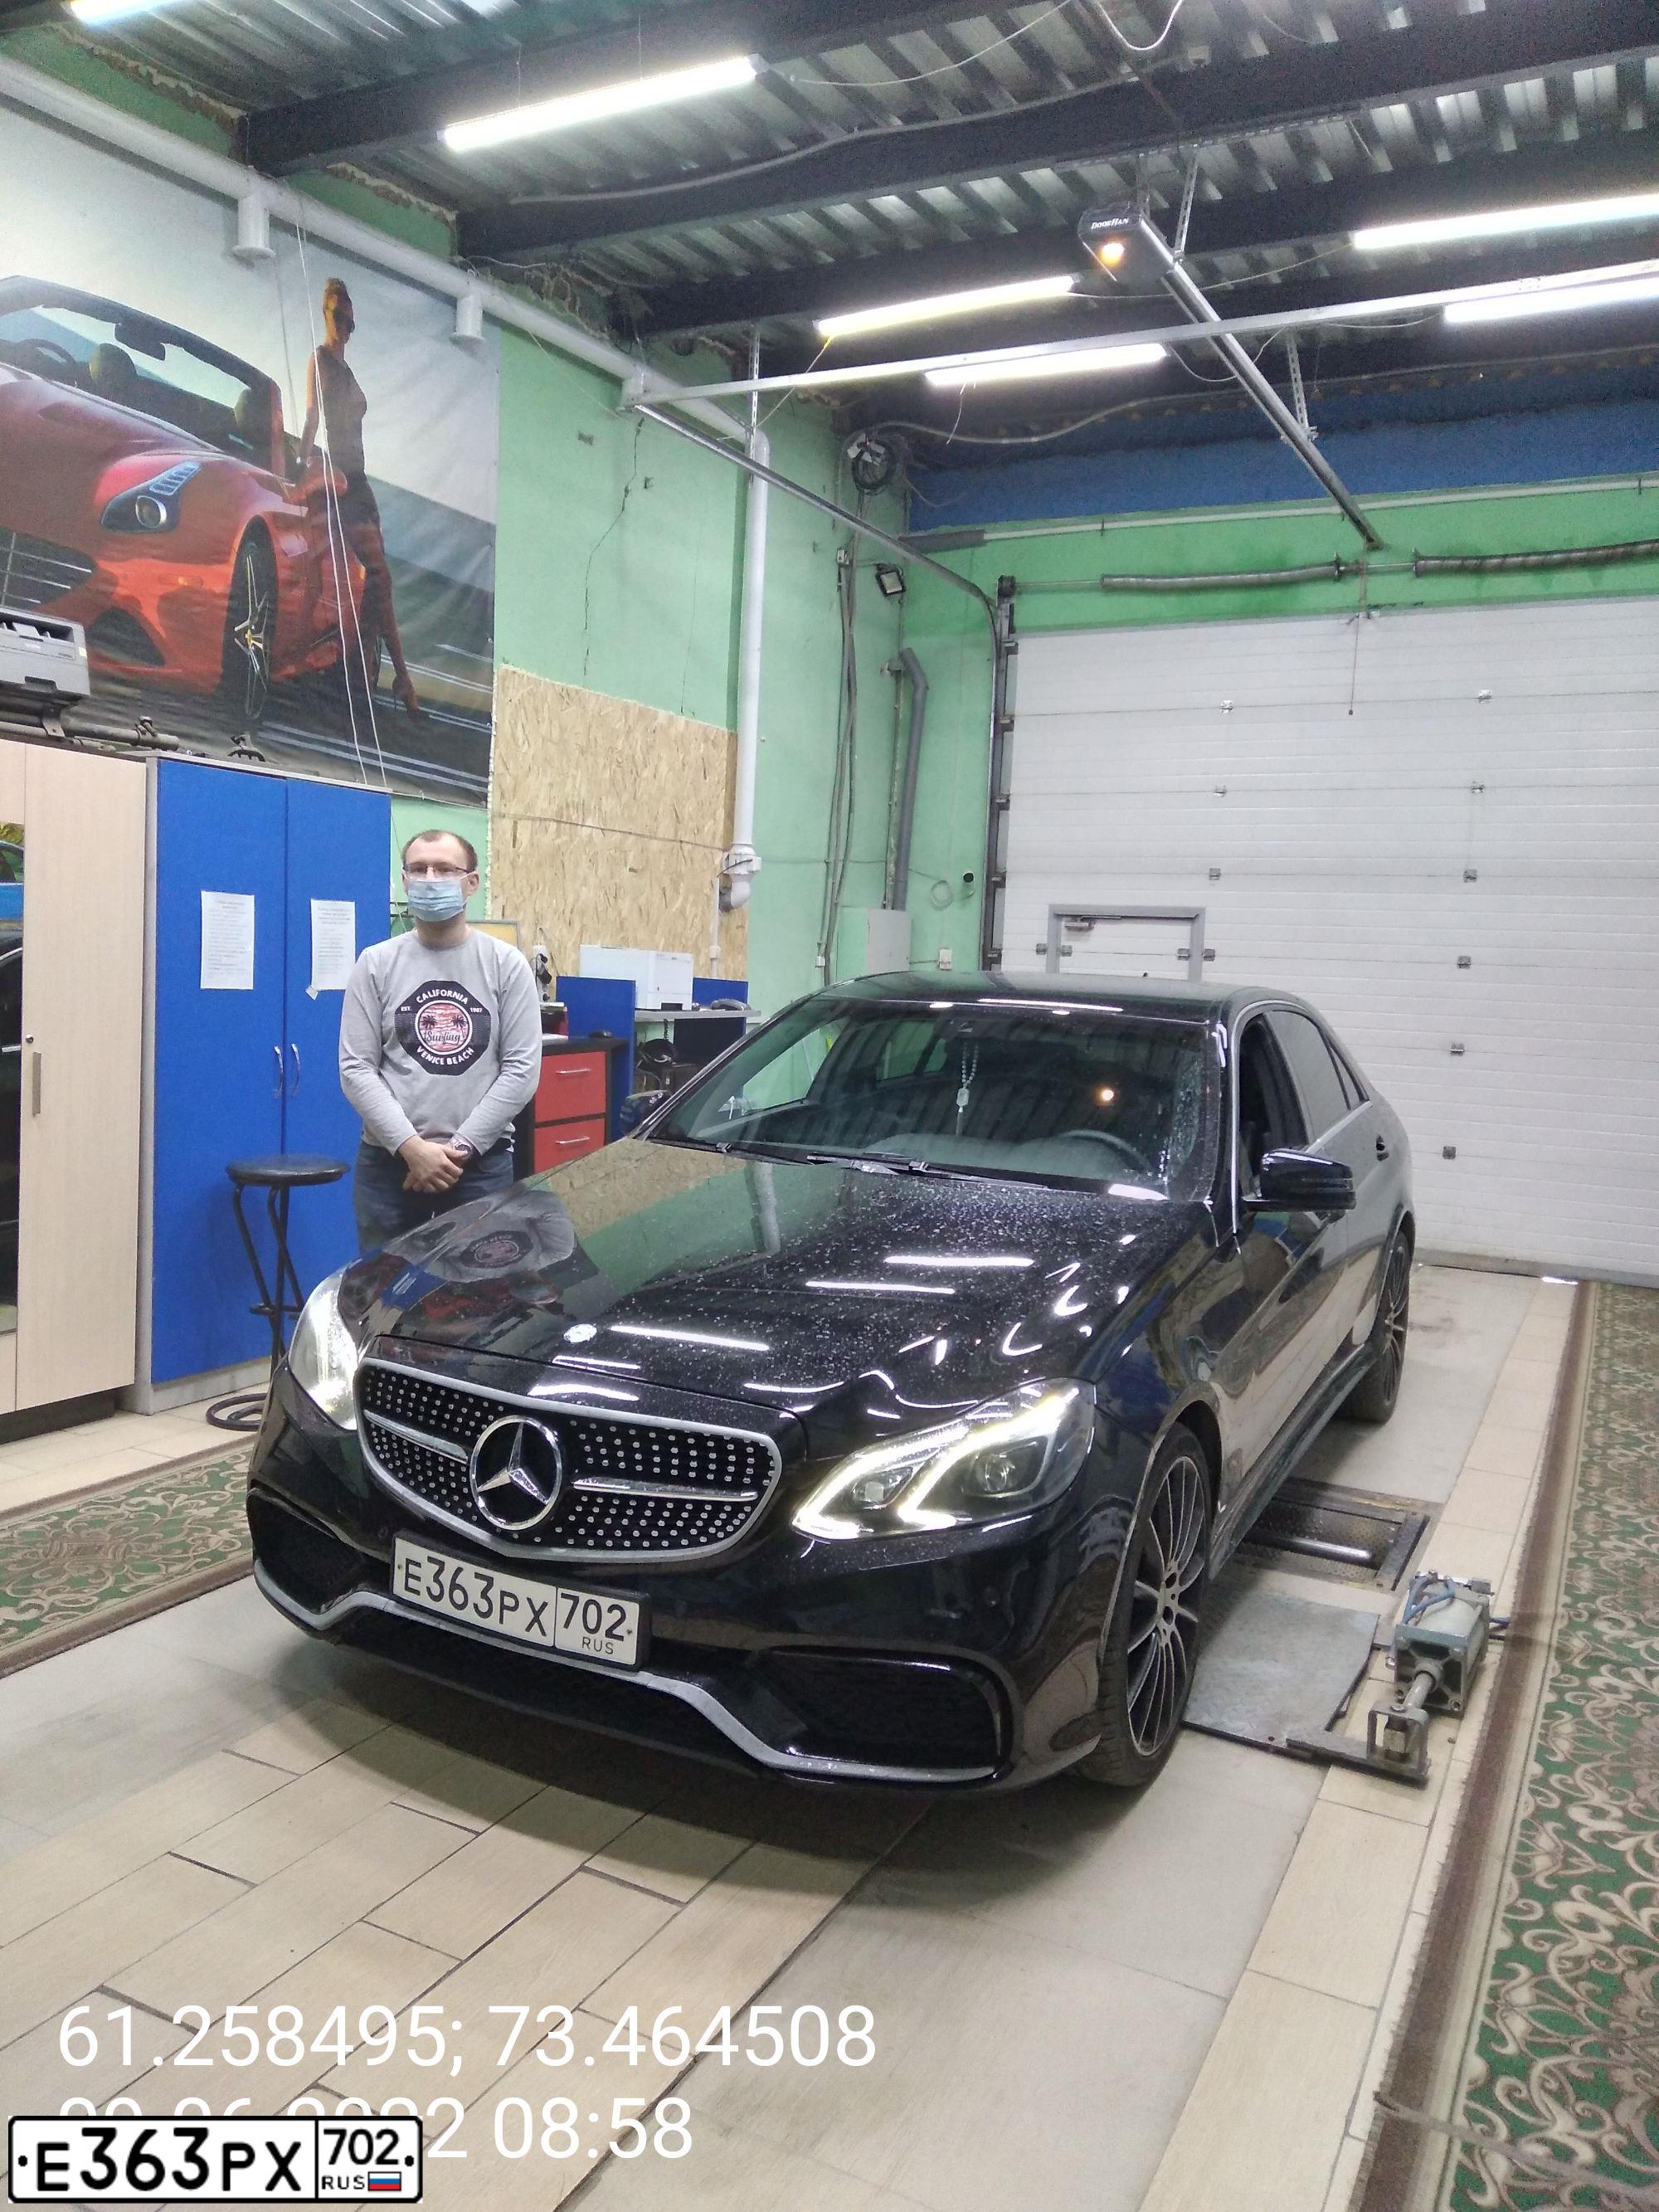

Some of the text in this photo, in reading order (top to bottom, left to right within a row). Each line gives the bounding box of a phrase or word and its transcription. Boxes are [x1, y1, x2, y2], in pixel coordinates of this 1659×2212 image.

[416, 989, 469, 1005] CALIFORNIA
[416, 1045, 474, 1065] VENICE BEACH
[560, 1592, 627, 1642] 702
[581, 1636, 614, 1655] RUS
